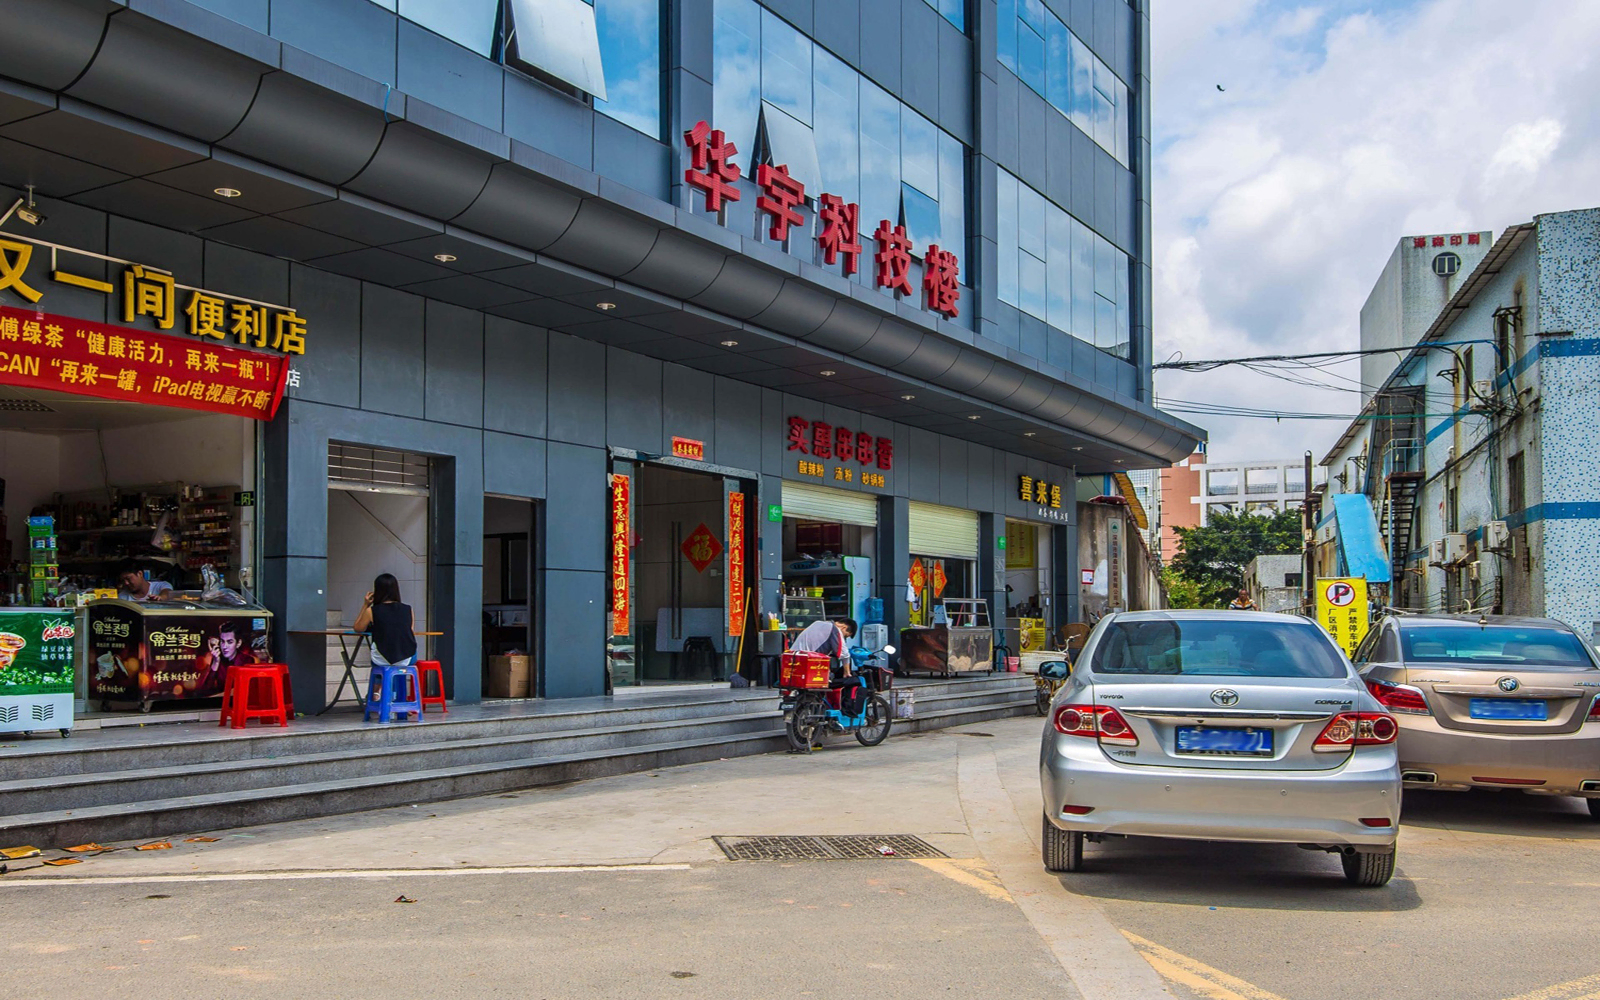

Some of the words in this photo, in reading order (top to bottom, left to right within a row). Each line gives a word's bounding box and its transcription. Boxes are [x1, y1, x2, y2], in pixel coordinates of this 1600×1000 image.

[683, 120, 960, 318] 华宇科技楼
[0, 239, 307, 355] 又一间便利店
[0, 316, 64, 348] 傅绿茶
[0, 351, 40, 377] CAN
[285, 369, 301, 388] 店
[787, 415, 894, 470] 实惠串串香
[798, 460, 825, 478] 酸辣粉
[834, 466, 853, 483] 汤粉
[1020, 475, 1061, 509] 喜来堡
[690, 534, 713, 562] 福
[149, 631, 202, 649] 蒂兰圣雪
